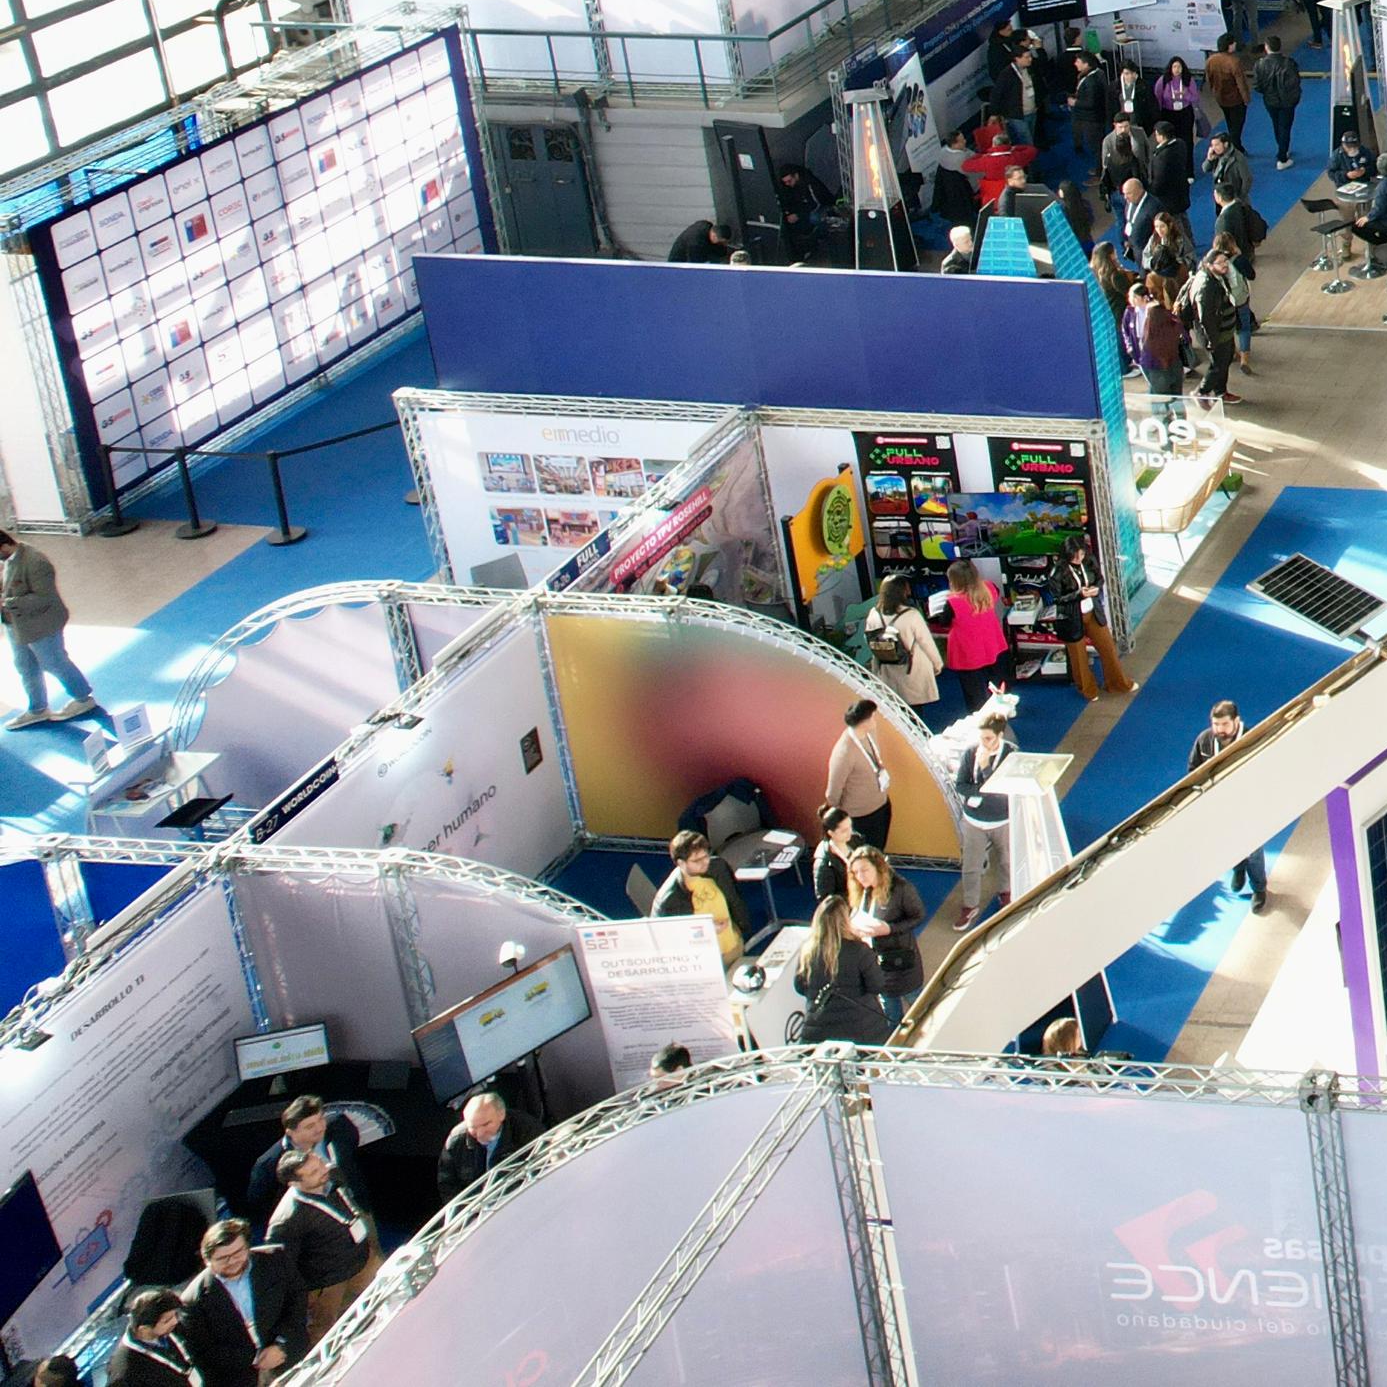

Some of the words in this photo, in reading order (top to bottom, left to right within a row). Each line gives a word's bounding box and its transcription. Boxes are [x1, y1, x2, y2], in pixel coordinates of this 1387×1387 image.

[886, 448, 923, 458] FULL
[886, 455, 940, 466] URBANO
[1020, 453, 1057, 464] FULL
[1021, 462, 1075, 474] URBANO
[613, 535, 658, 581] PROYECTO
[655, 517, 673, 541] TPV
[670, 492, 709, 524] ROSEHILL
[575, 542, 600, 565] FULL
[255, 815, 279, 842] B-27
[281, 763, 339, 815] WORLDCOIN
[442, 783, 497, 840] humano
[601, 954, 690, 969] OUTSOURCING
[607, 965, 689, 980] DESARROLLO
[69, 984, 134, 1042] DESARROLLO
